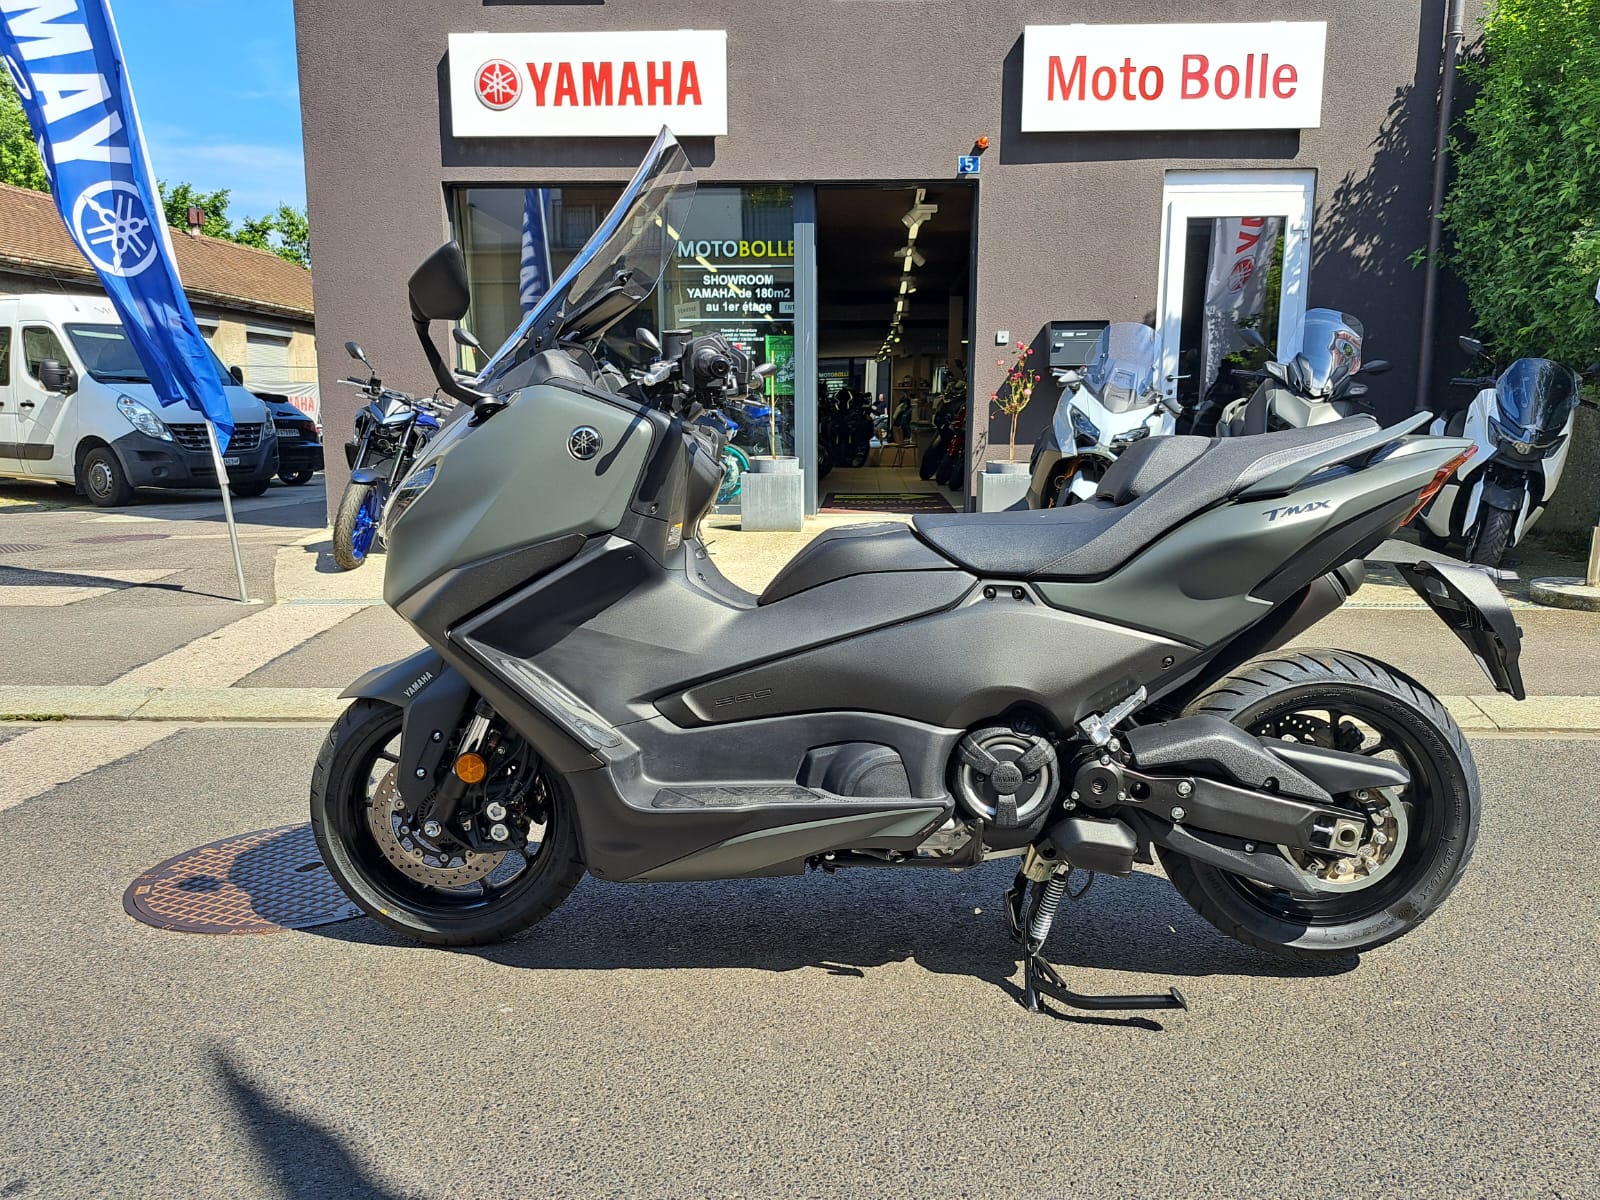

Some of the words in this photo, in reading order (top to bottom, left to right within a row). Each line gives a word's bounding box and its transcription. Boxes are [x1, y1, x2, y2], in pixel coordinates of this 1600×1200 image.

[526, 61, 702, 106] YAMAHA
[1047, 56, 1164, 101] Moto
[1181, 53, 1298, 100] Bolle
[965, 158, 974, 171] 5
[703, 275, 773, 285] SHOWROOM
[687, 288, 737, 298] YAMAHA
[739, 288, 752, 298] de
[755, 288, 791, 298] 180m2
[706, 303, 719, 312] au
[722, 302, 740, 312] 1er
[742, 301, 772, 313] étage
[1262, 499, 1332, 521] TMAX
[402, 671, 433, 697] YAMAHA
[715, 688, 772, 707] 560
